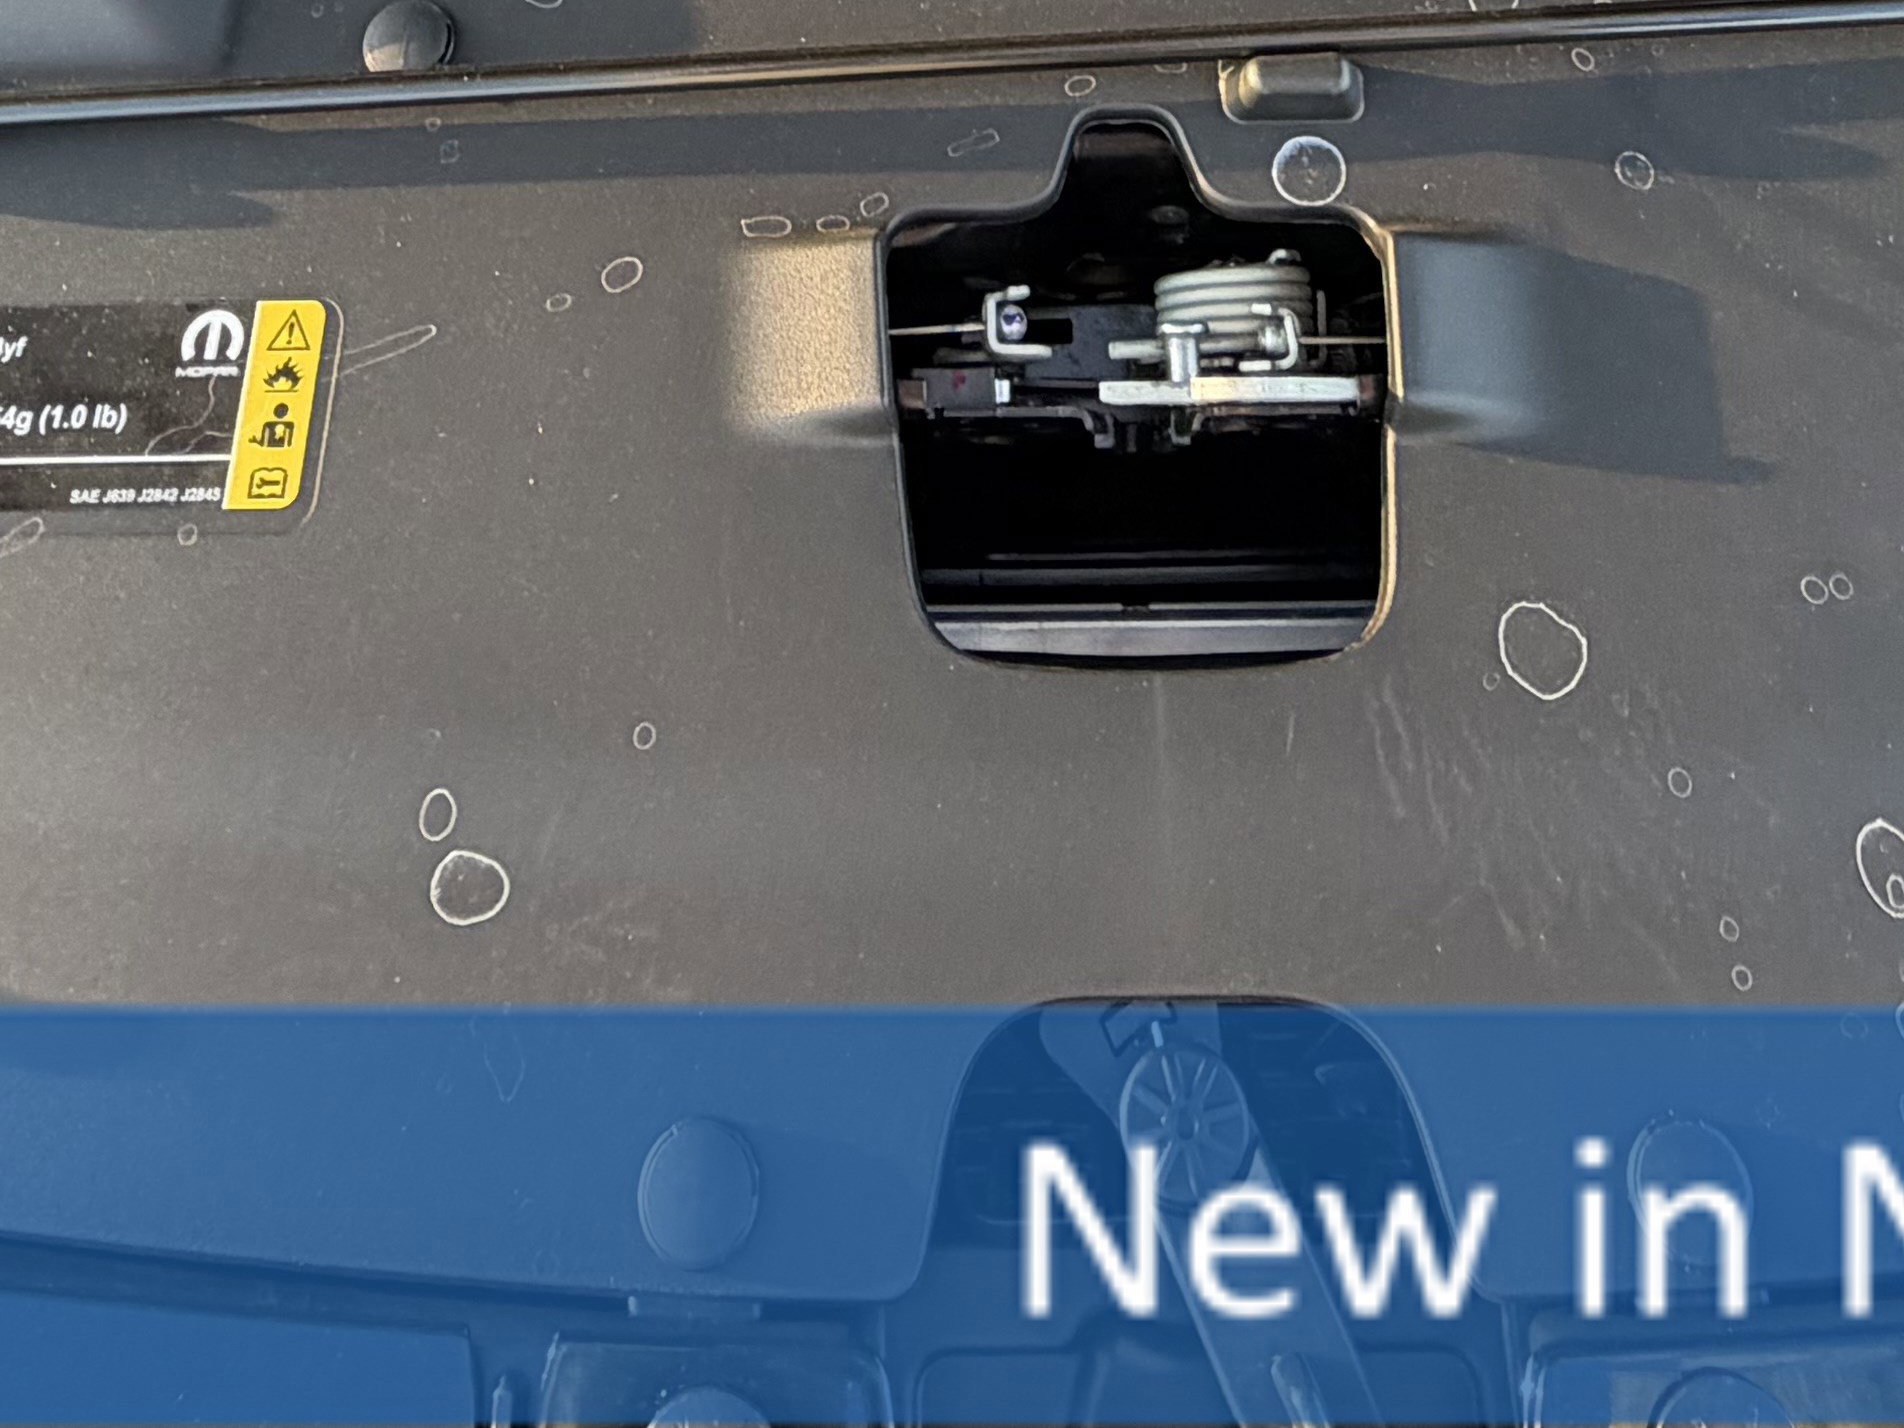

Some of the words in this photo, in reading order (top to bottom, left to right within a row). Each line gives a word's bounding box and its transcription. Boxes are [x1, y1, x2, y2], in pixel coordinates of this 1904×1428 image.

[38, 403, 88, 436] (1.0
[92, 402, 129, 435] lb)
[70, 488, 101, 504] SAE
